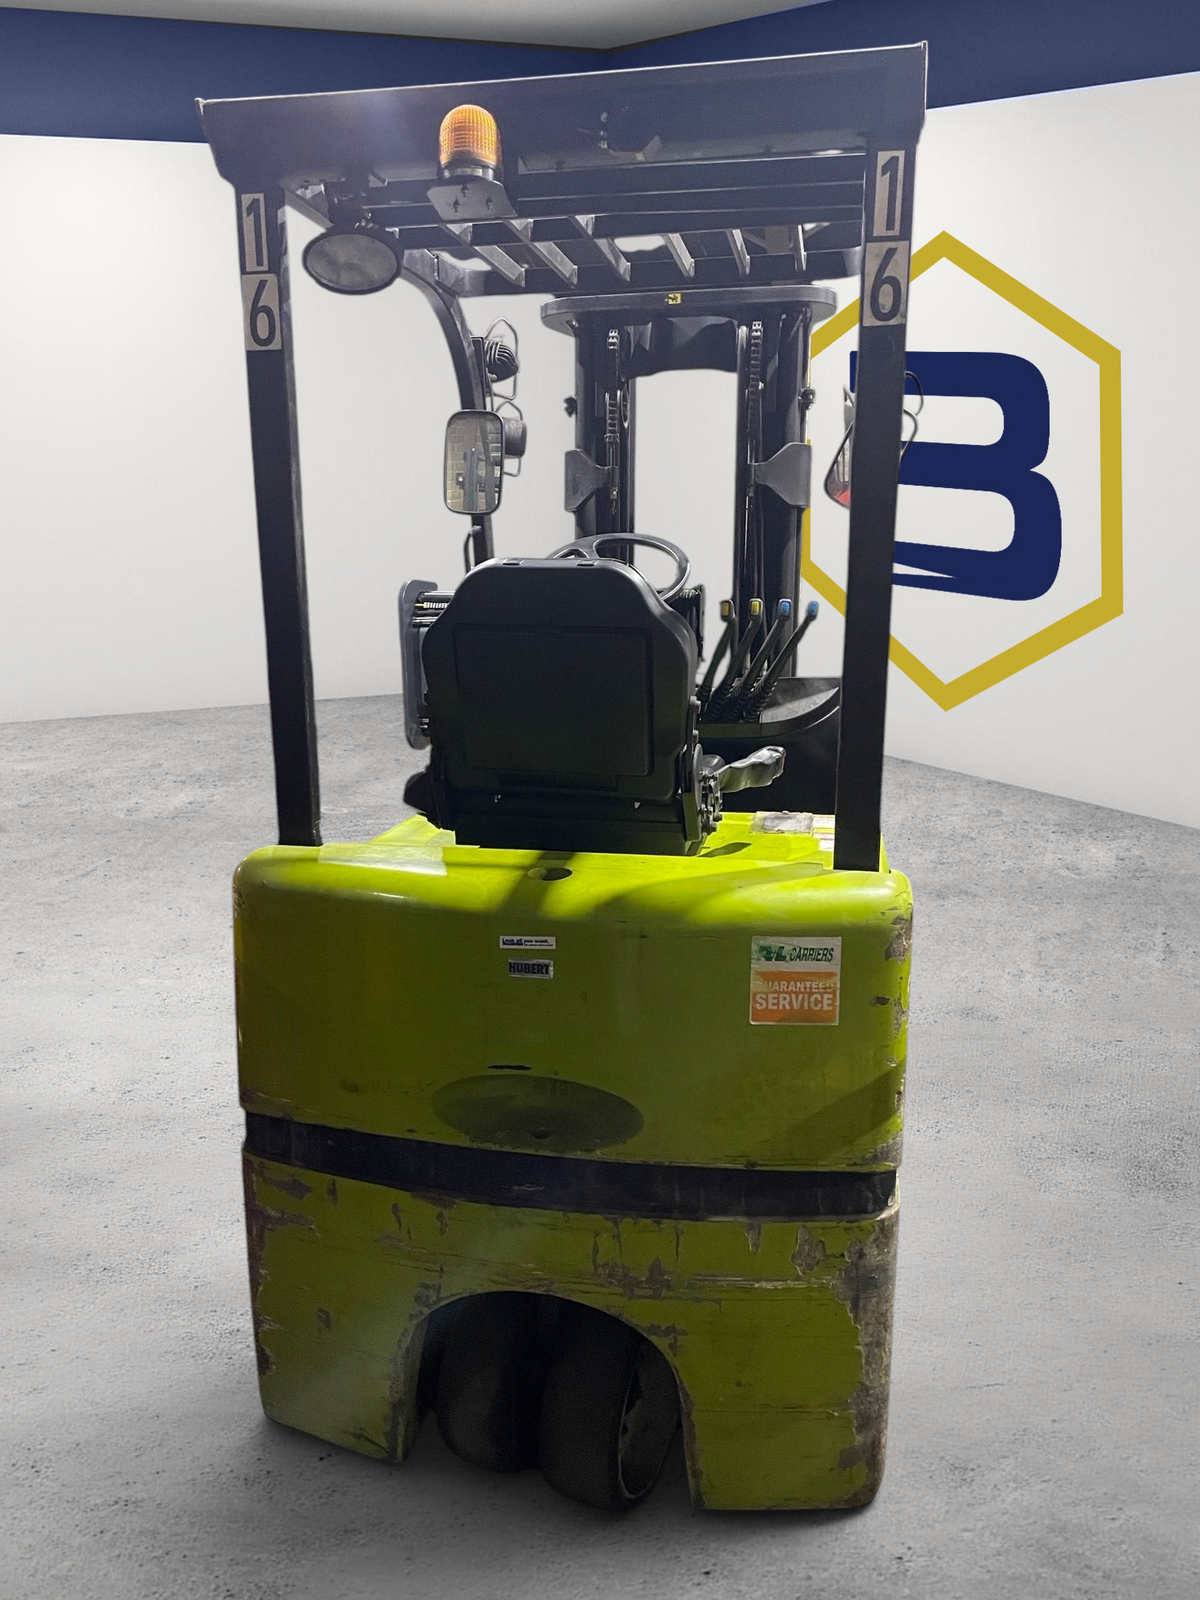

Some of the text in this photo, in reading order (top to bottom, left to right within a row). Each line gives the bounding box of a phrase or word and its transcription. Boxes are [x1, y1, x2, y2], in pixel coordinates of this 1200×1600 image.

[246, 198, 276, 347] 16
[870, 155, 902, 322] 16
[849, 350, 1063, 601] B
[509, 961, 550, 975] HUBERT
[755, 993, 833, 1011] SERVICE
